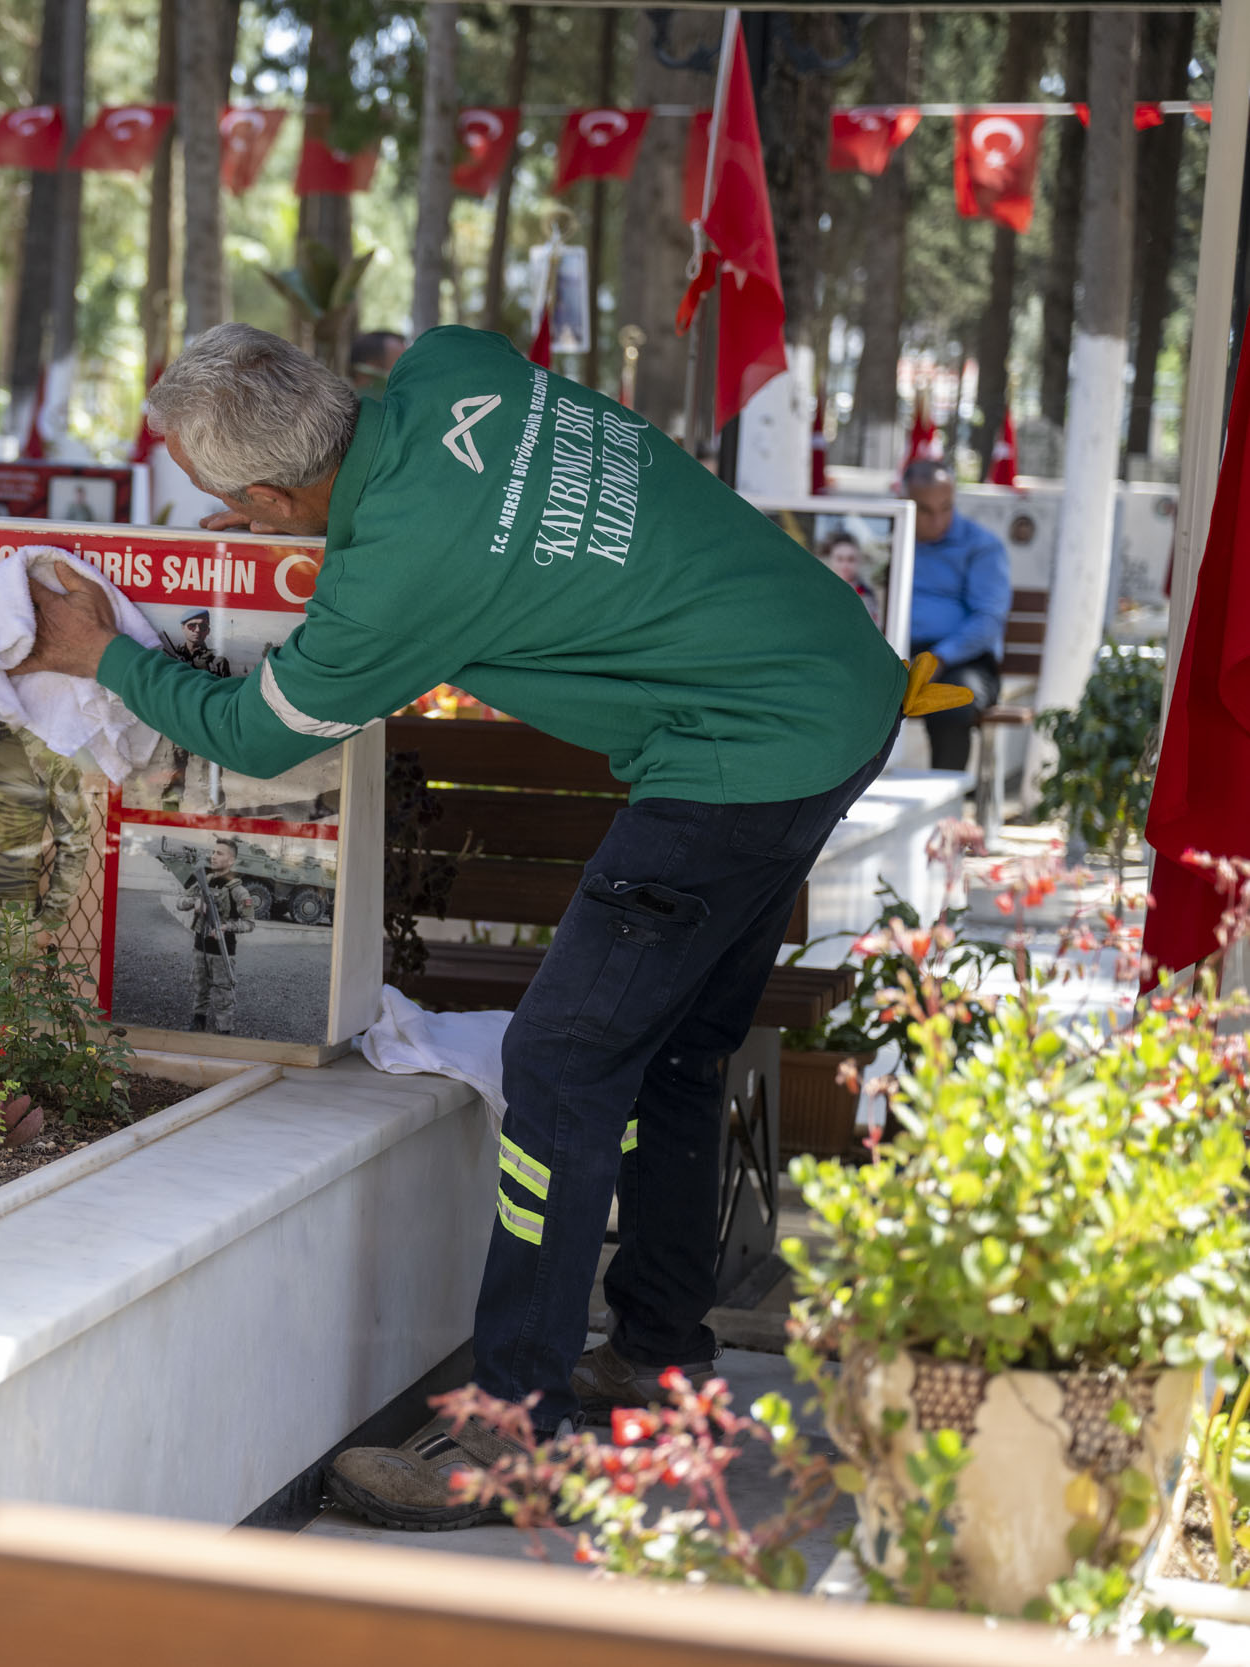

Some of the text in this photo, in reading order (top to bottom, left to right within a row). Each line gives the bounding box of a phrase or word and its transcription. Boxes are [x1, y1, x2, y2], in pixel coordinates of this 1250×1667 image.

[510, 413, 543, 477] BÜYÜKŞEHİR
[499, 478, 525, 530] MERSİN
[533, 397, 594, 566] KAYBIMIZ BİR
[587, 410, 652, 567] KALBİMİZ BİR
[490, 532, 509, 554] T.C.
[162, 552, 256, 594] ŞAHİN
